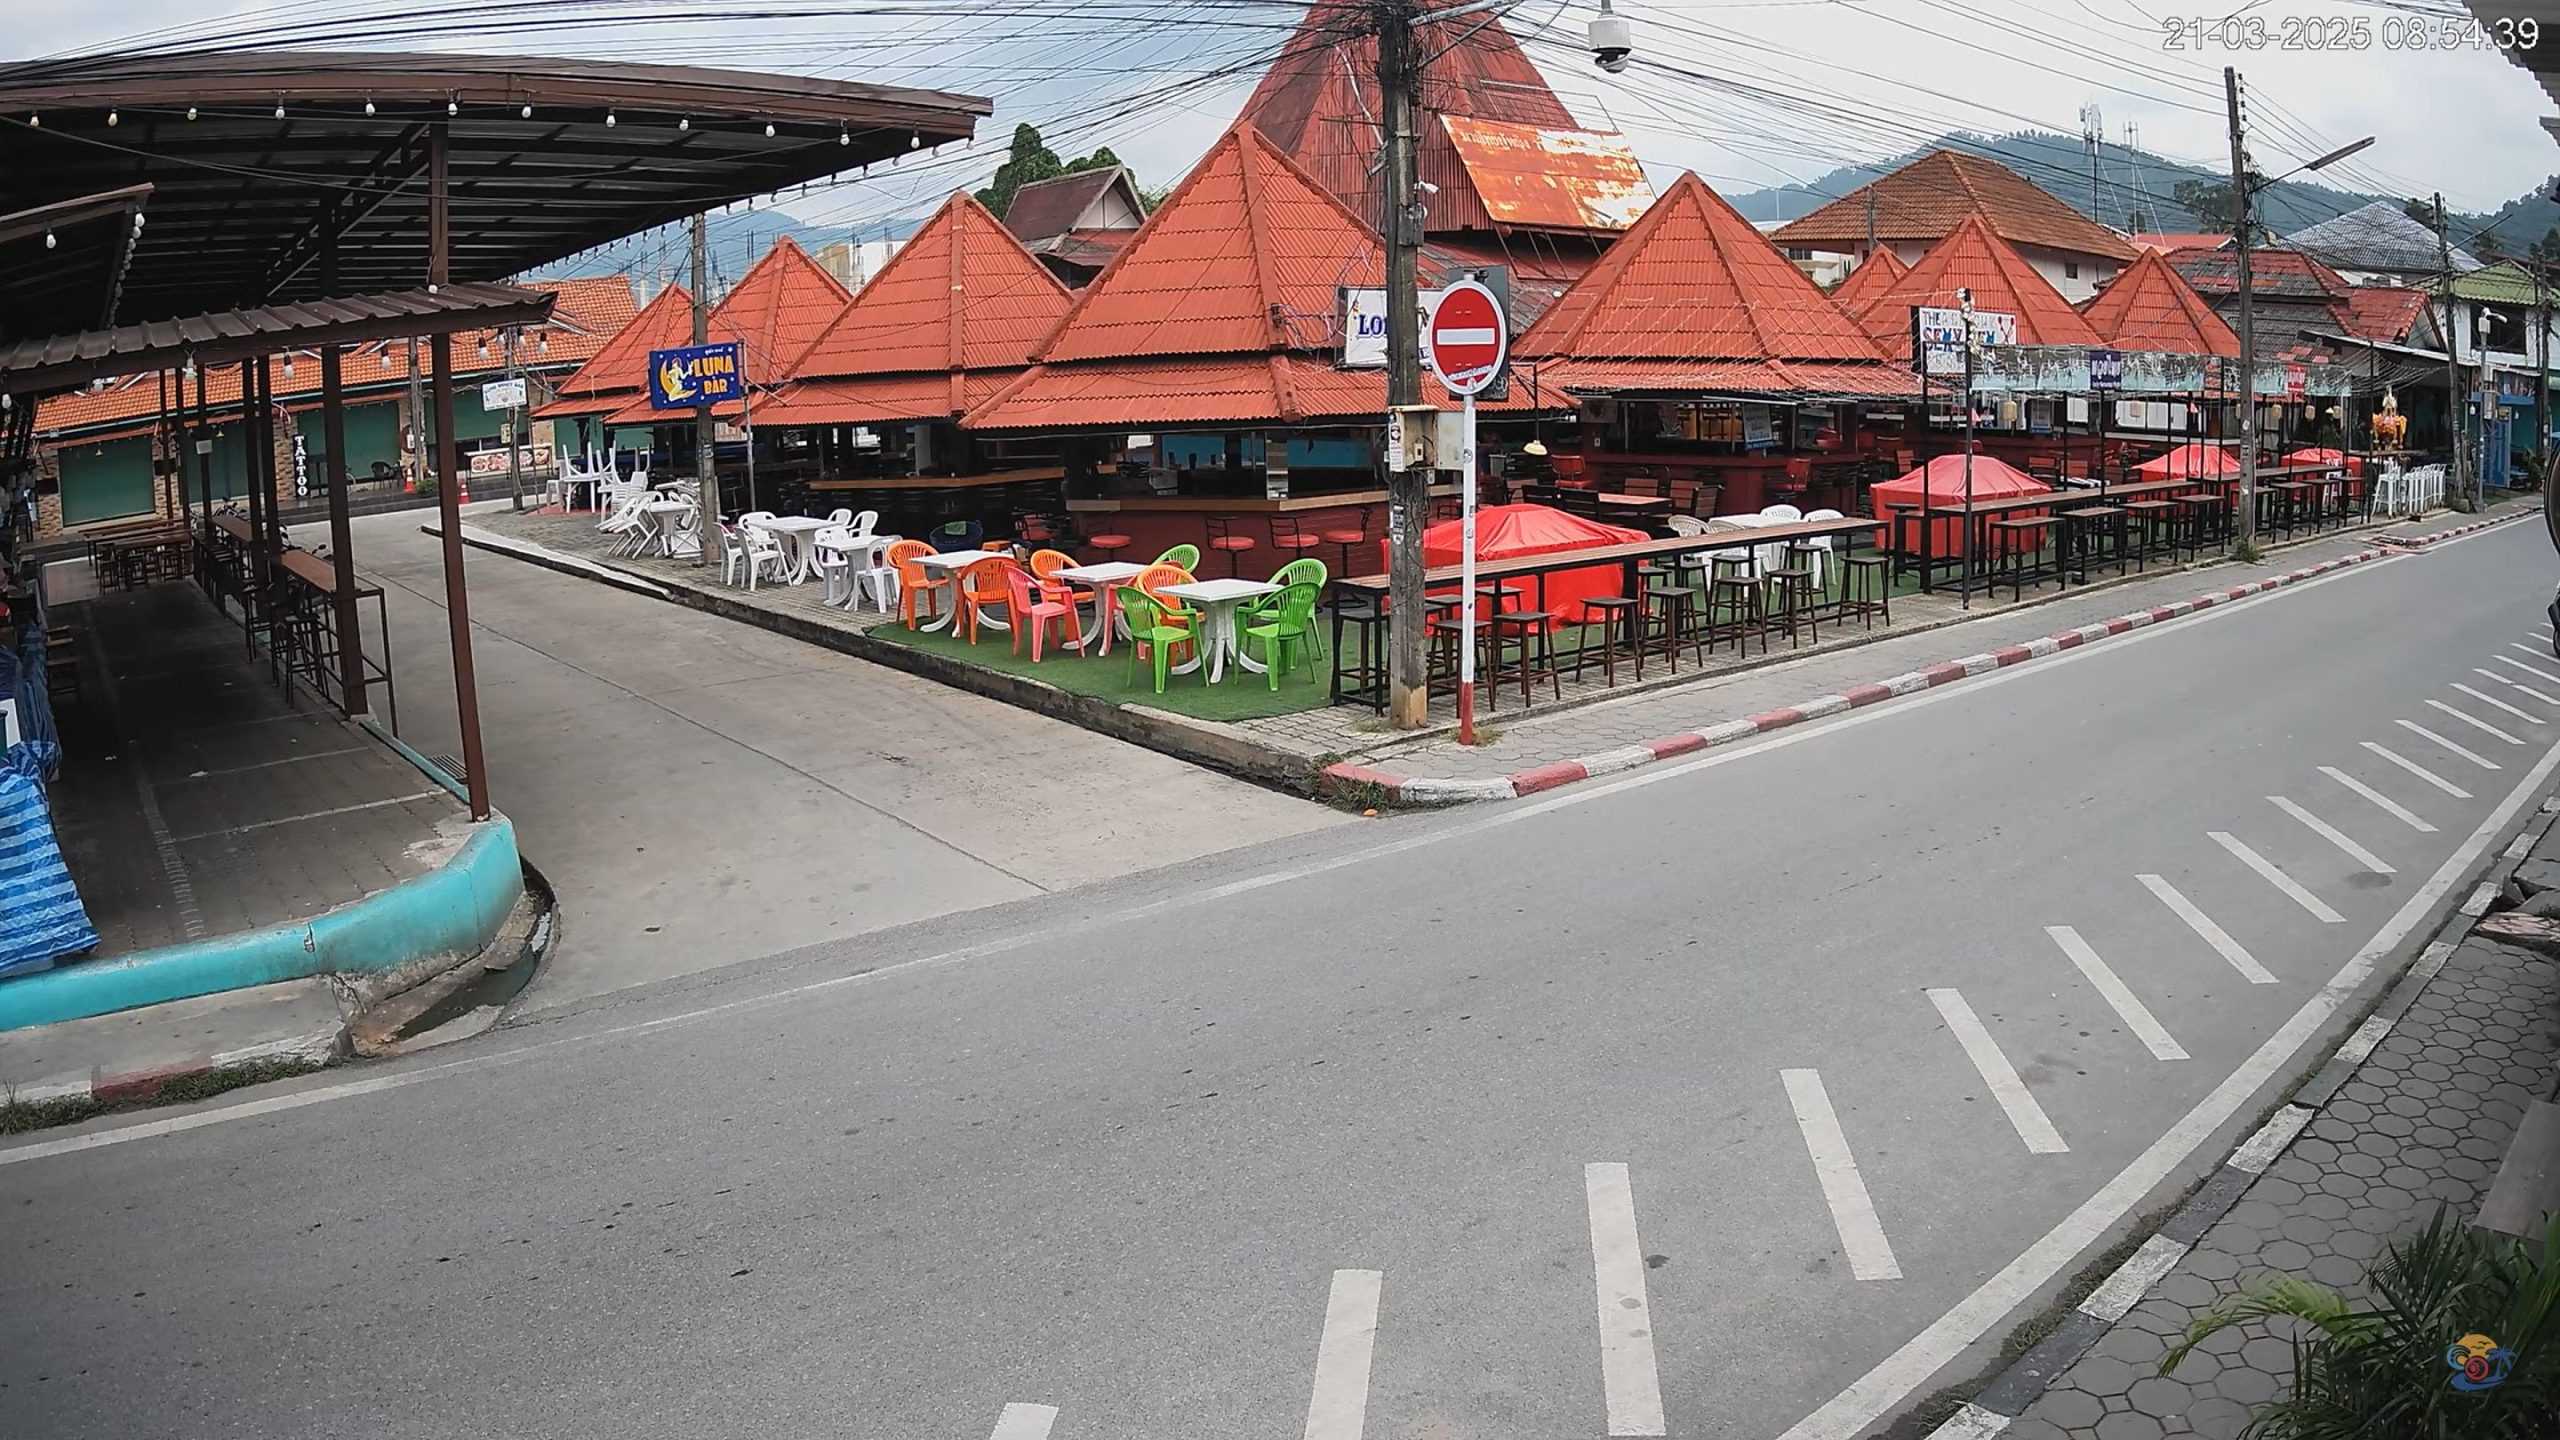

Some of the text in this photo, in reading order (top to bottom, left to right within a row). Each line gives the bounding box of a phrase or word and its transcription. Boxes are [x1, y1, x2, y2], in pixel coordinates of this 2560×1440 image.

[1358, 314, 1387, 336] LO
[693, 355, 735, 378] LUNA
[703, 378, 728, 395] BAR
[294, 435, 308, 496] TATTOO
